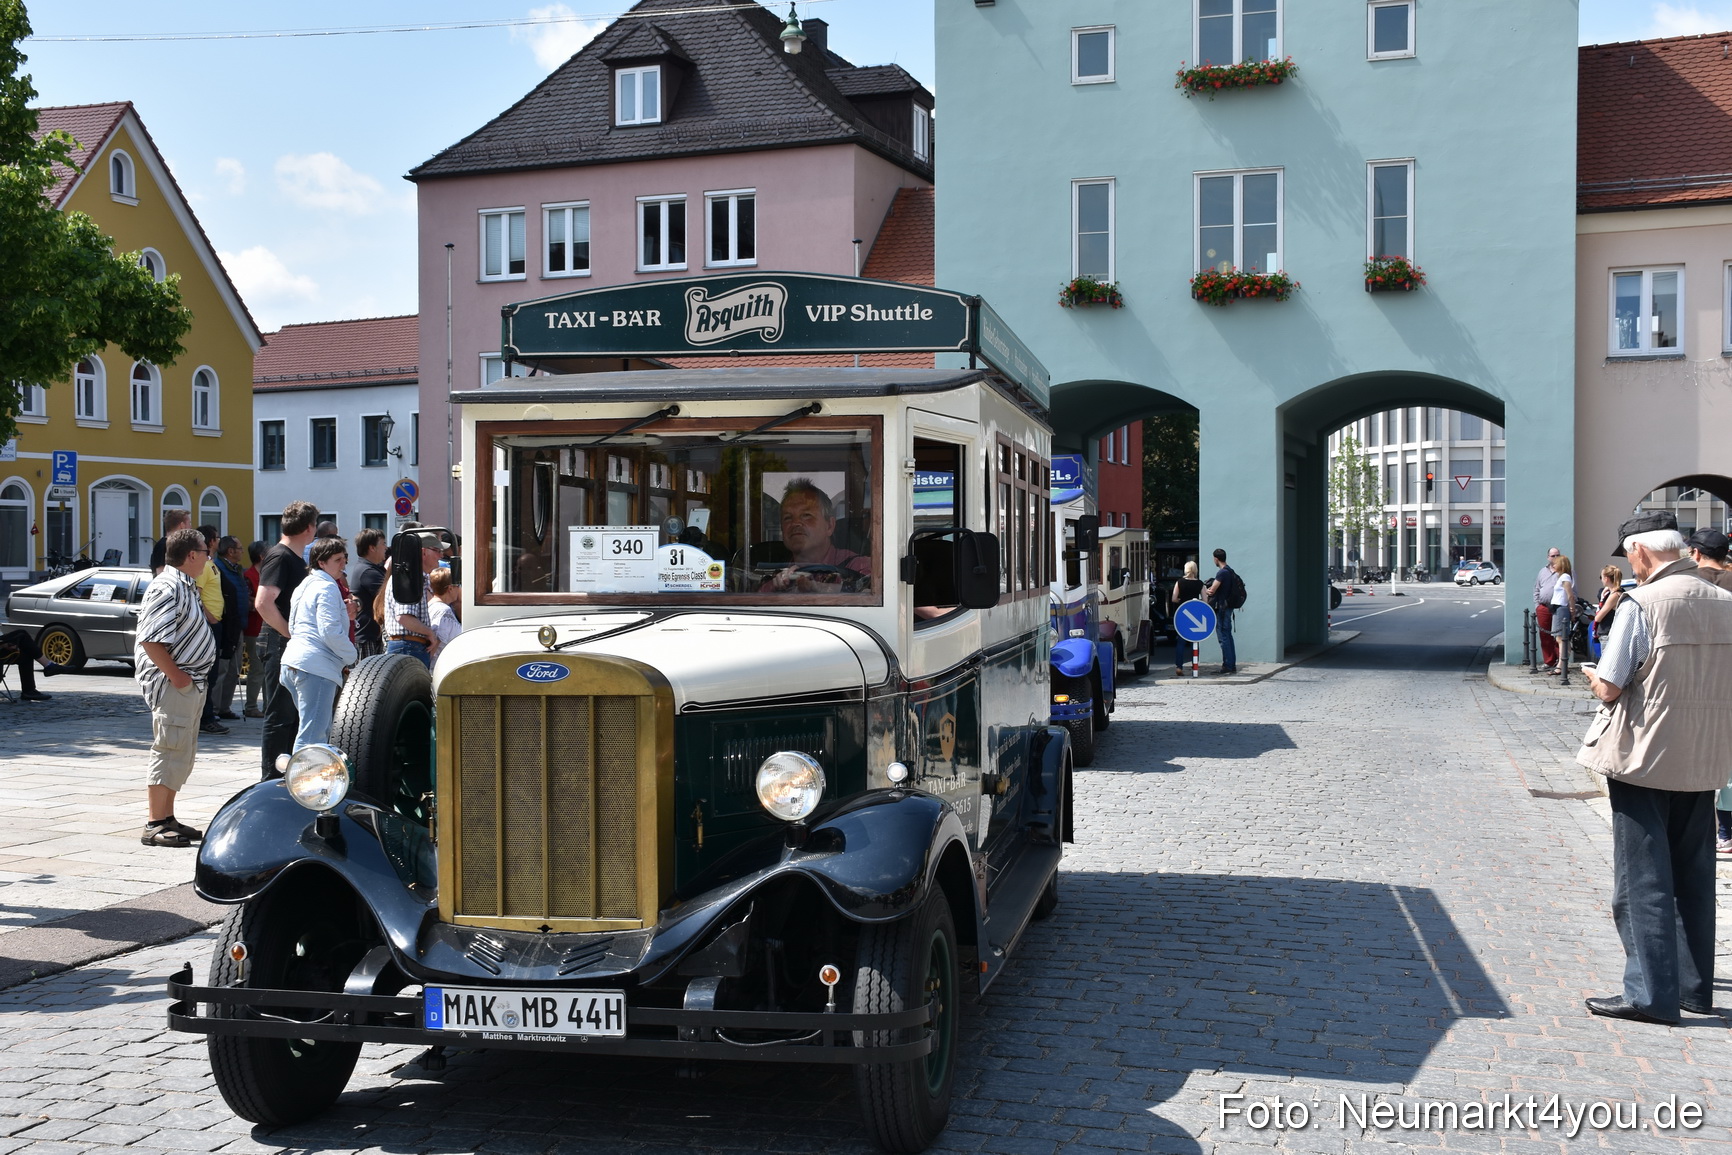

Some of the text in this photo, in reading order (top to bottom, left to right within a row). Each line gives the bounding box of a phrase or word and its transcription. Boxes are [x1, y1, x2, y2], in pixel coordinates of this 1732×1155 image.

[544, 308, 662, 329] TAXI-BÄR
[695, 293, 775, 334] Asquith
[805, 302, 934, 323] VIP Shuttle
[612, 539, 643, 555] 340
[670, 548, 685, 566] 31
[526, 664, 559, 678] Ford
[430, 1011, 438, 1022] D
[444, 993, 622, 1031] MAK MB 44H
[482, 1032, 567, 1043] Matthes Marktredwitz
